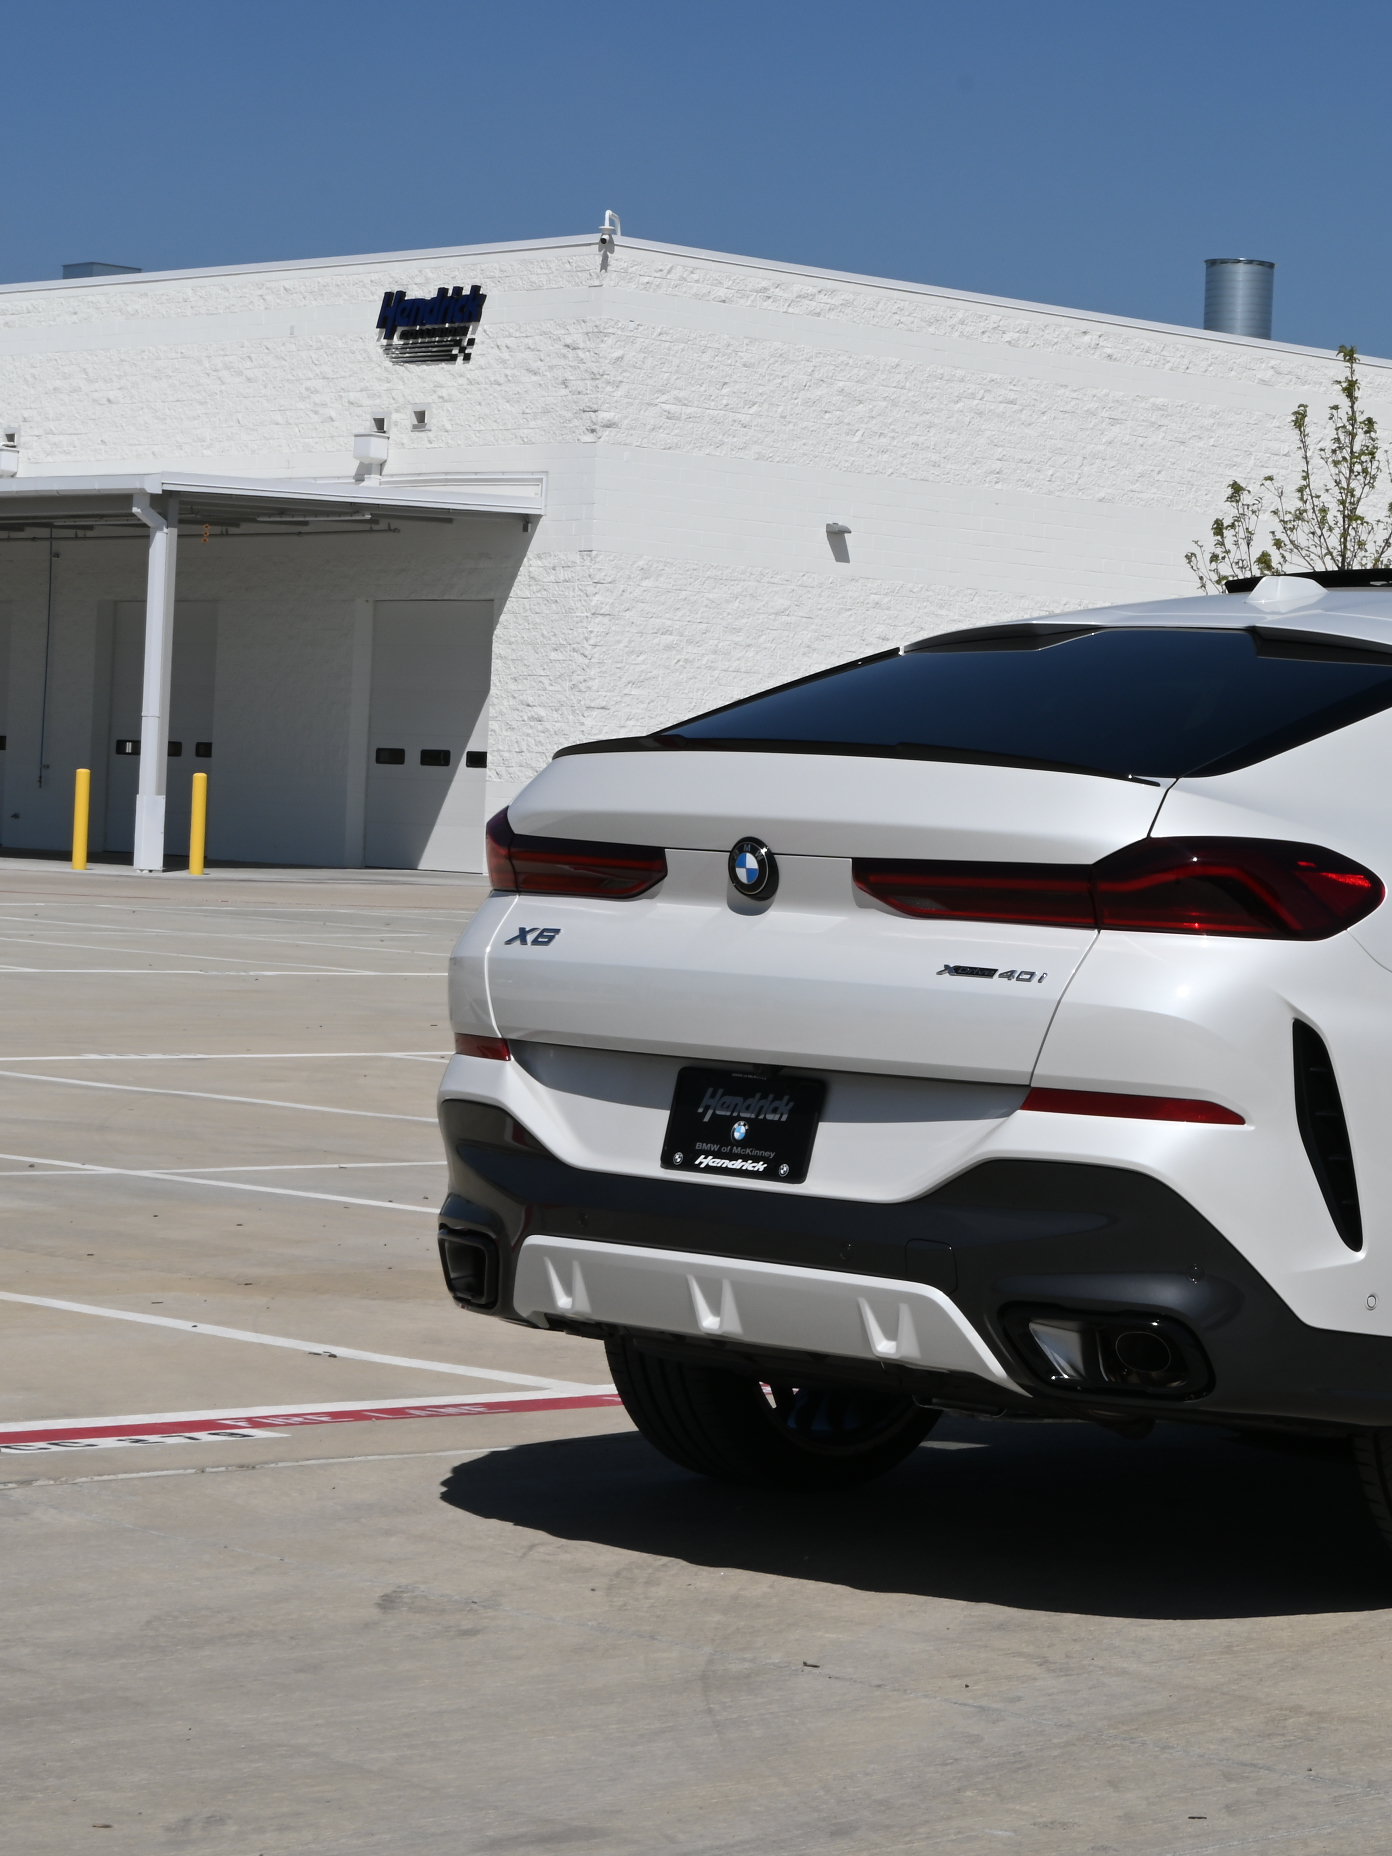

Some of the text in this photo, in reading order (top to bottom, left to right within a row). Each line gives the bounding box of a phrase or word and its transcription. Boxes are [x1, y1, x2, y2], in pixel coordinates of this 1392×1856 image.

[376, 285, 487, 340] Hendrick
[504, 927, 562, 946] X6
[698, 1088, 794, 1122] Hendrick
[695, 1142, 720, 1151] BMW
[732, 1147, 775, 1158] McKinney
[695, 1155, 767, 1171] Hendrick
[217, 1406, 510, 1427] FIRE LANE
